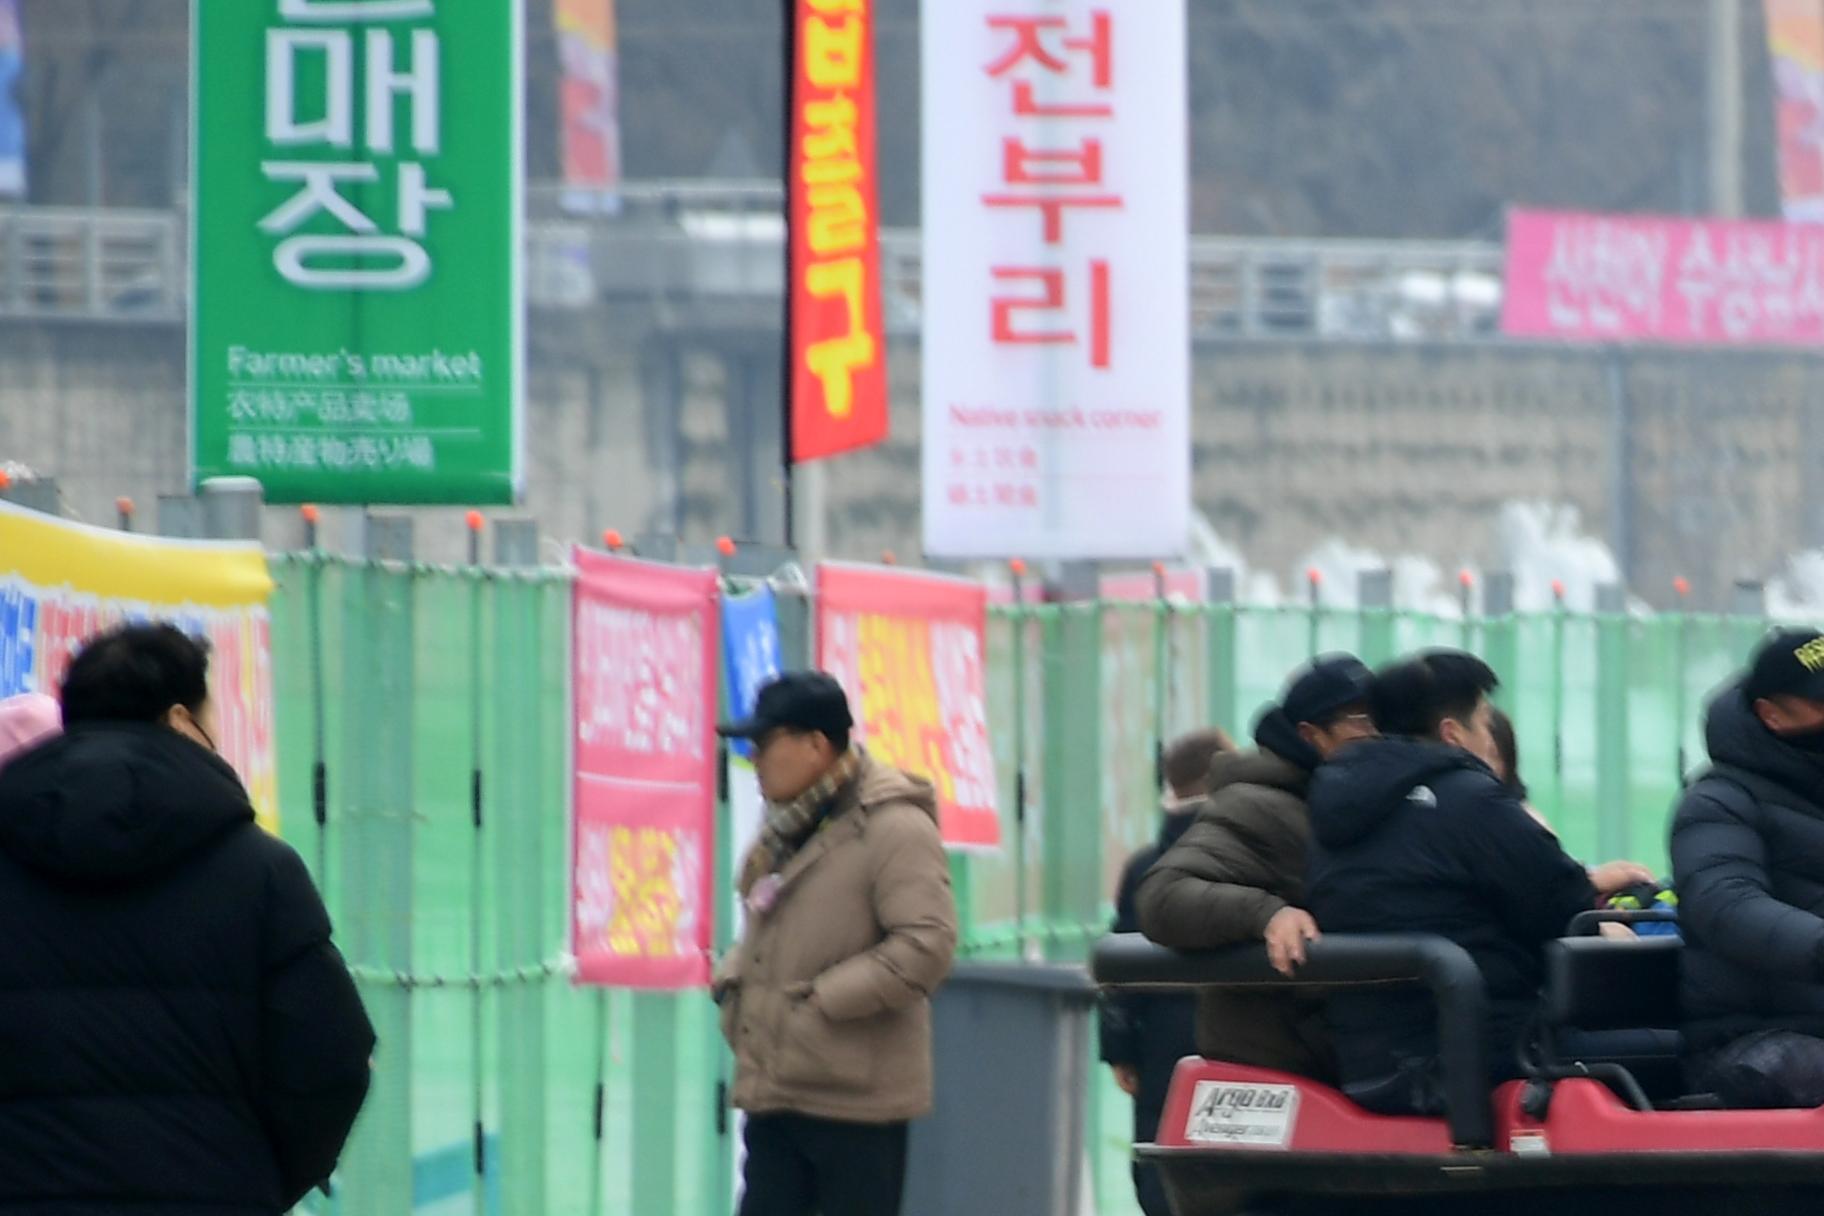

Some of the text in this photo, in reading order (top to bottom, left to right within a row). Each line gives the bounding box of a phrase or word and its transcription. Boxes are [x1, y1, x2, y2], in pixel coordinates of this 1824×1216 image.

[257, 0, 454, 288] 매장
[982, 10, 1124, 371] 전부리
[227, 345, 482, 382] Farmer's market
[1194, 1086, 1257, 1118] Argo
